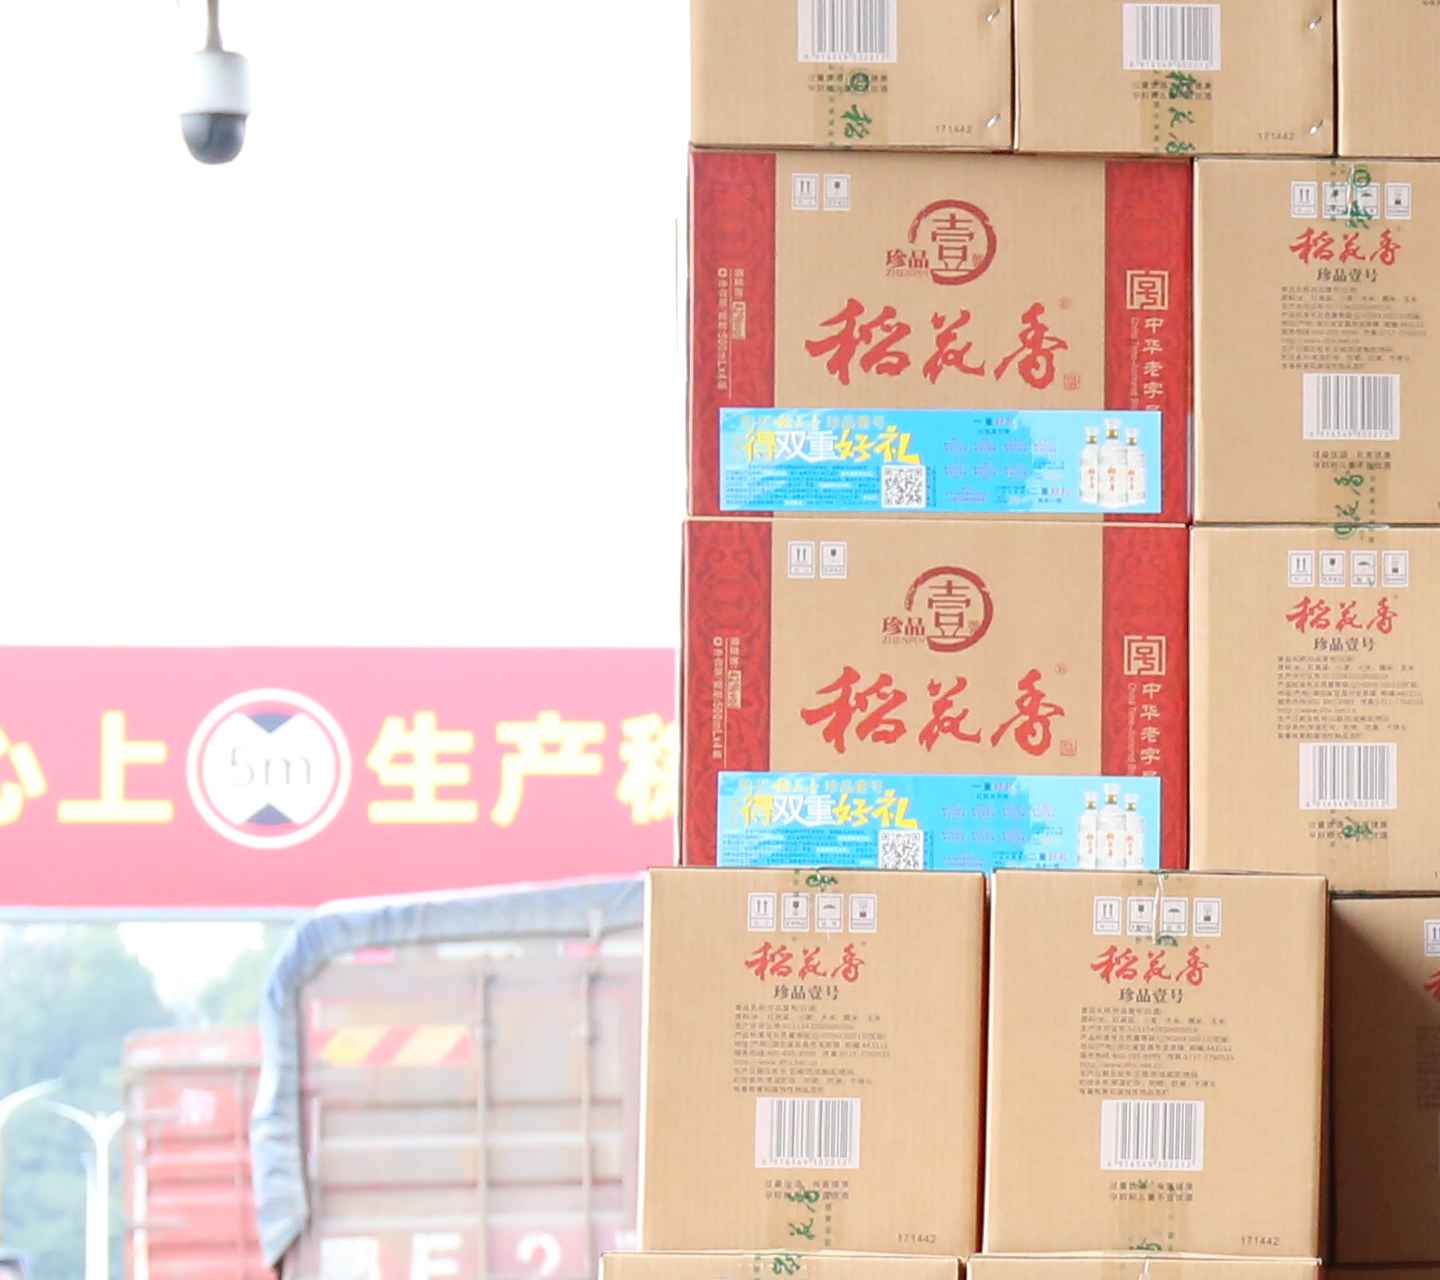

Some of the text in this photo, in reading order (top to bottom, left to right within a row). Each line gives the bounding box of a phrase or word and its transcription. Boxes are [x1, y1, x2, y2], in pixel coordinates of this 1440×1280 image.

[1289, 227, 1401, 268] 稻花香
[804, 298, 1069, 390] 稻花香
[1143, 316, 1164, 411] 中华老字
[1285, 596, 1399, 636] 稻花香
[801, 665, 1066, 757] 稻花香
[743, 941, 860, 983] 稻花香
[1089, 944, 1206, 989] 稻花香
[773, 983, 840, 1002] 珍品壹号
